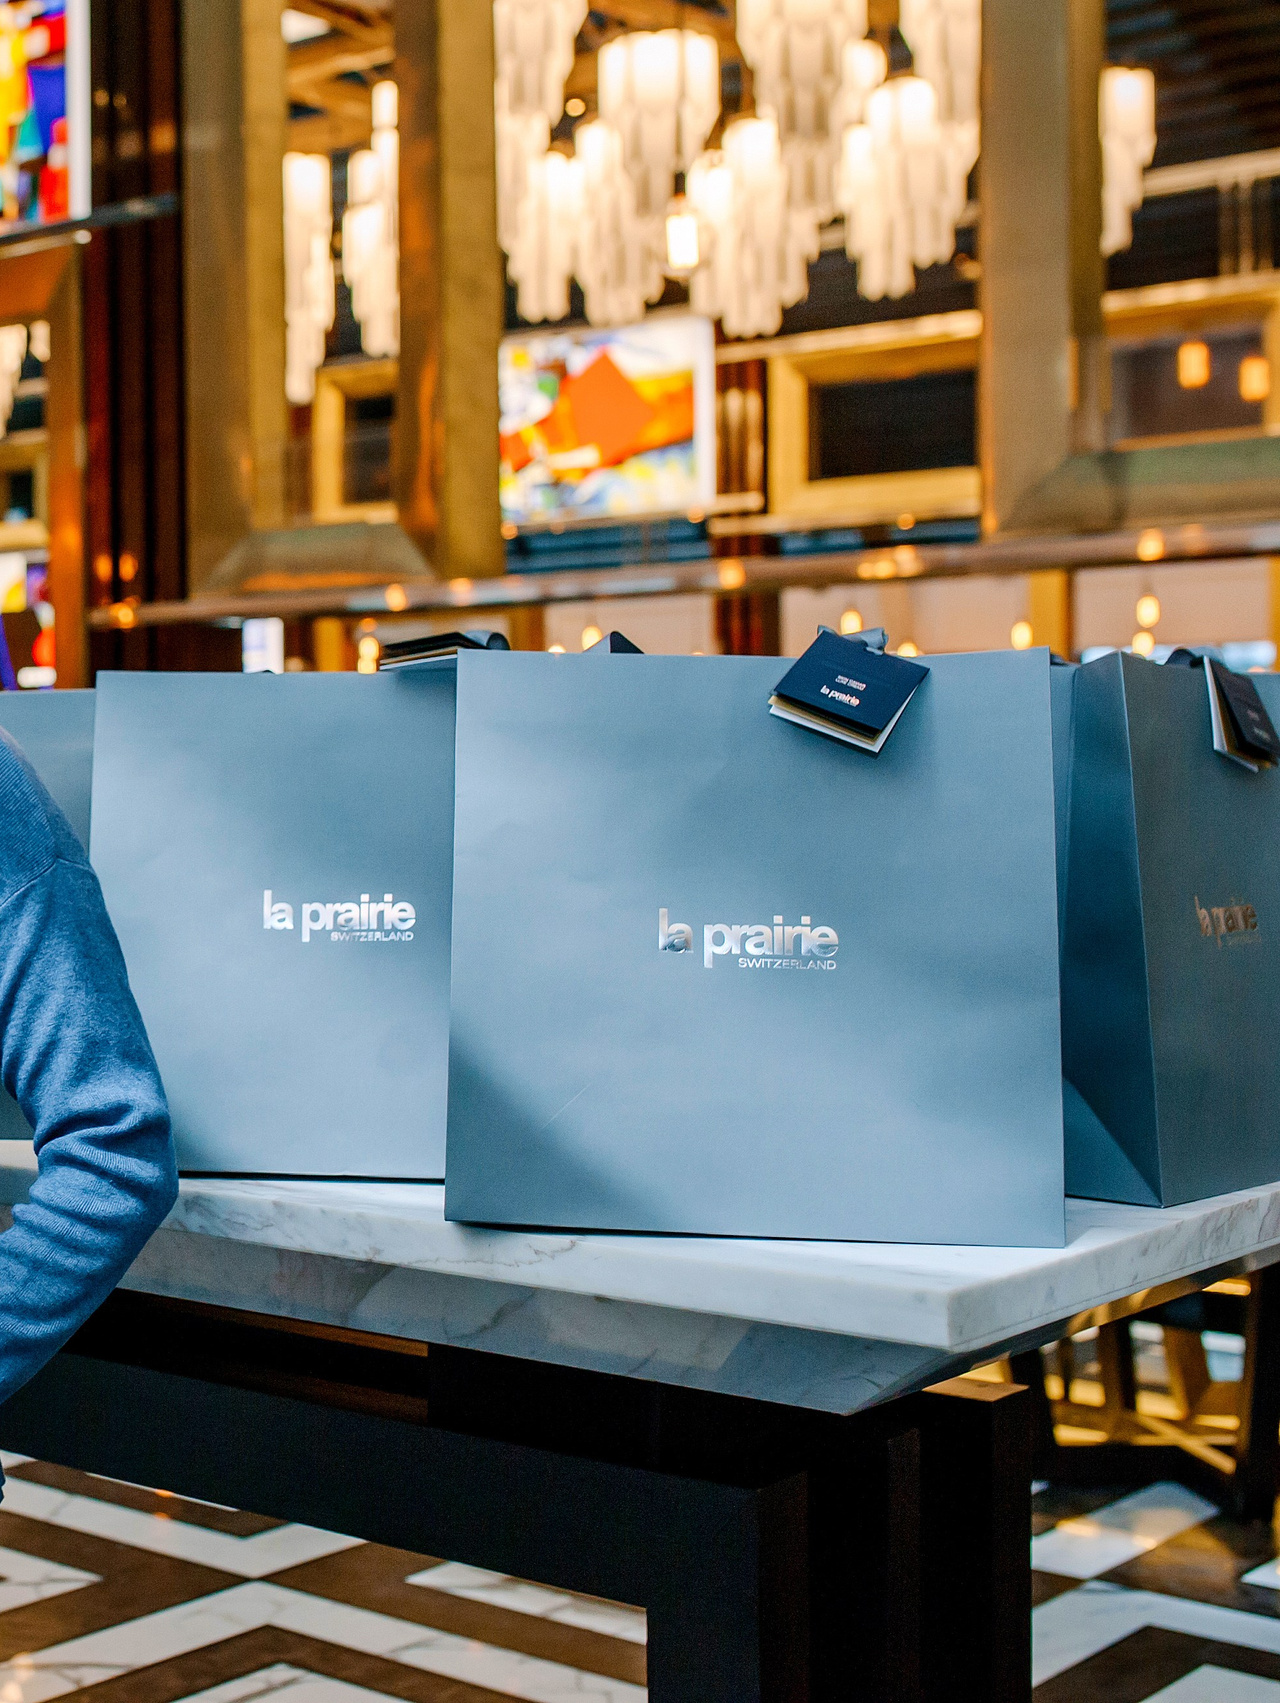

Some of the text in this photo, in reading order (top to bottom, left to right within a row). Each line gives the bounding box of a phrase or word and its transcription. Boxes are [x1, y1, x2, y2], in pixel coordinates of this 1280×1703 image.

[820, 684, 830, 695] la
[263, 889, 416, 942] la prairie
[330, 931, 414, 942] SWITZERLAND
[658, 907, 839, 968] la prairie
[738, 958, 837, 970] SWITZERLAND
